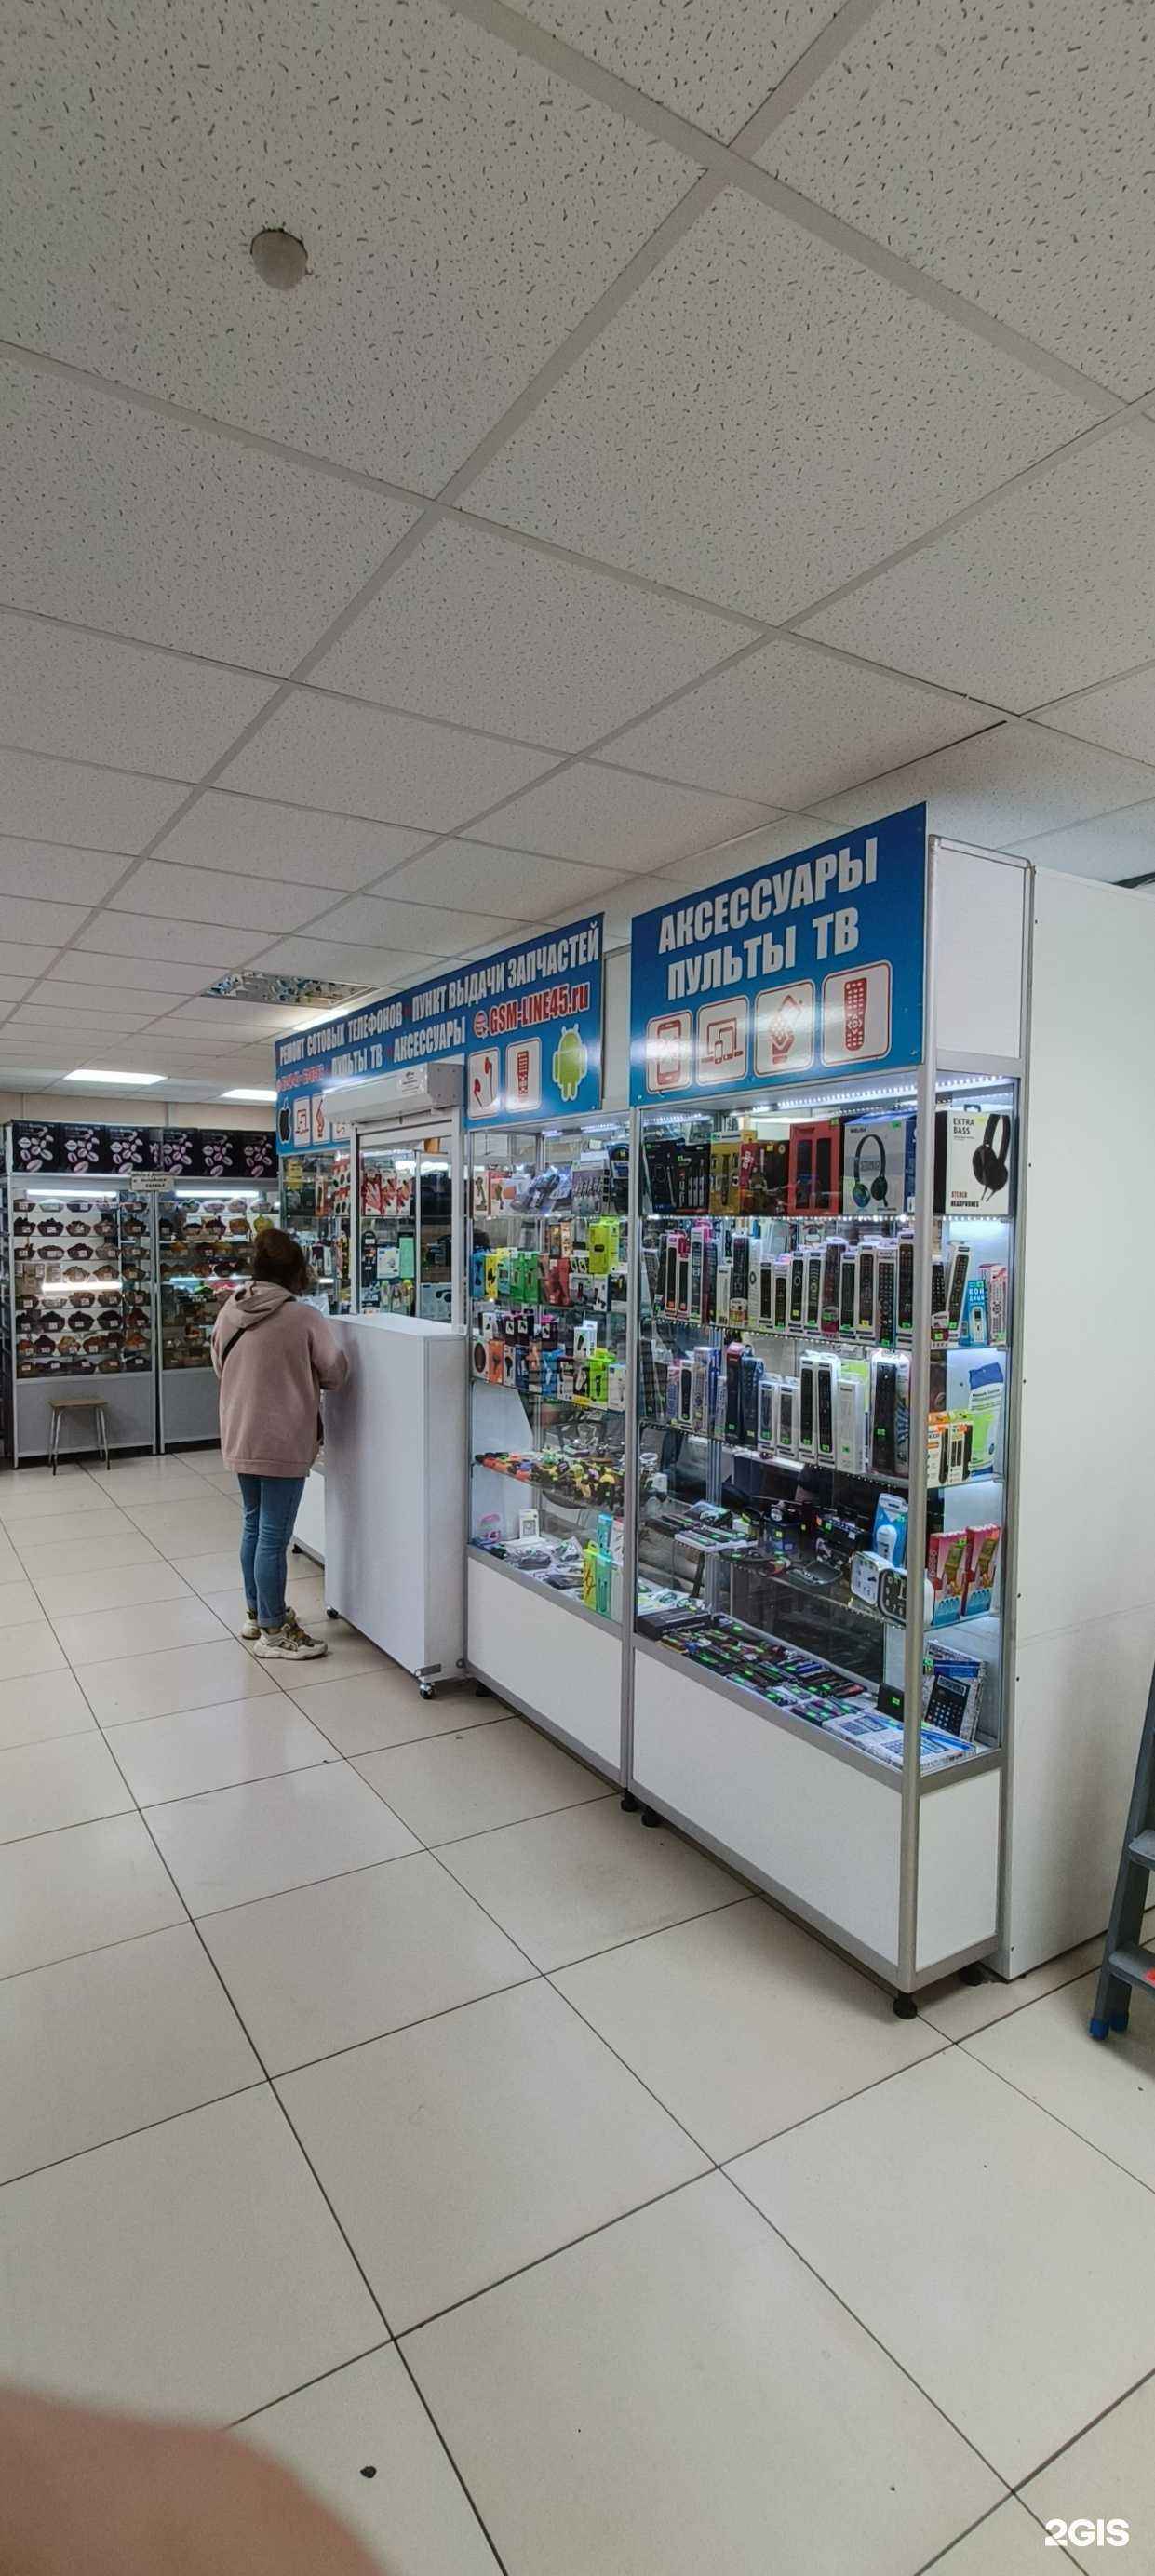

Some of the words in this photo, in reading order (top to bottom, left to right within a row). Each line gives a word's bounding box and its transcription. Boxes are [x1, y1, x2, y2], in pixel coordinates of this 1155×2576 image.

[658, 837, 878, 954] АКСЕССУАРЫ
[667, 926, 796, 1000] ПУЛЬТЫ
[813, 906, 859, 960] ТВ
[280, 1038, 305, 1066] РЕМОНТ
[307, 1024, 345, 1057] СОТОВЫХ
[348, 1002, 403, 1043] ТЕЛЕФОНОВ
[412, 986, 446, 1022] ПУНКТ
[449, 962, 505, 1010] ВЫДАЧИ
[507, 920, 600, 989] ЗАПЧАСТЕЙ
[489, 981, 591, 1037] GSM-LINE45.ru
[371, 1043, 383, 1070] ТВ
[394, 1016, 466, 1063] АКСЕССУАРЫ
[953, 1117, 975, 1127] EXTRA
[953, 1126, 971, 1135] BASS
